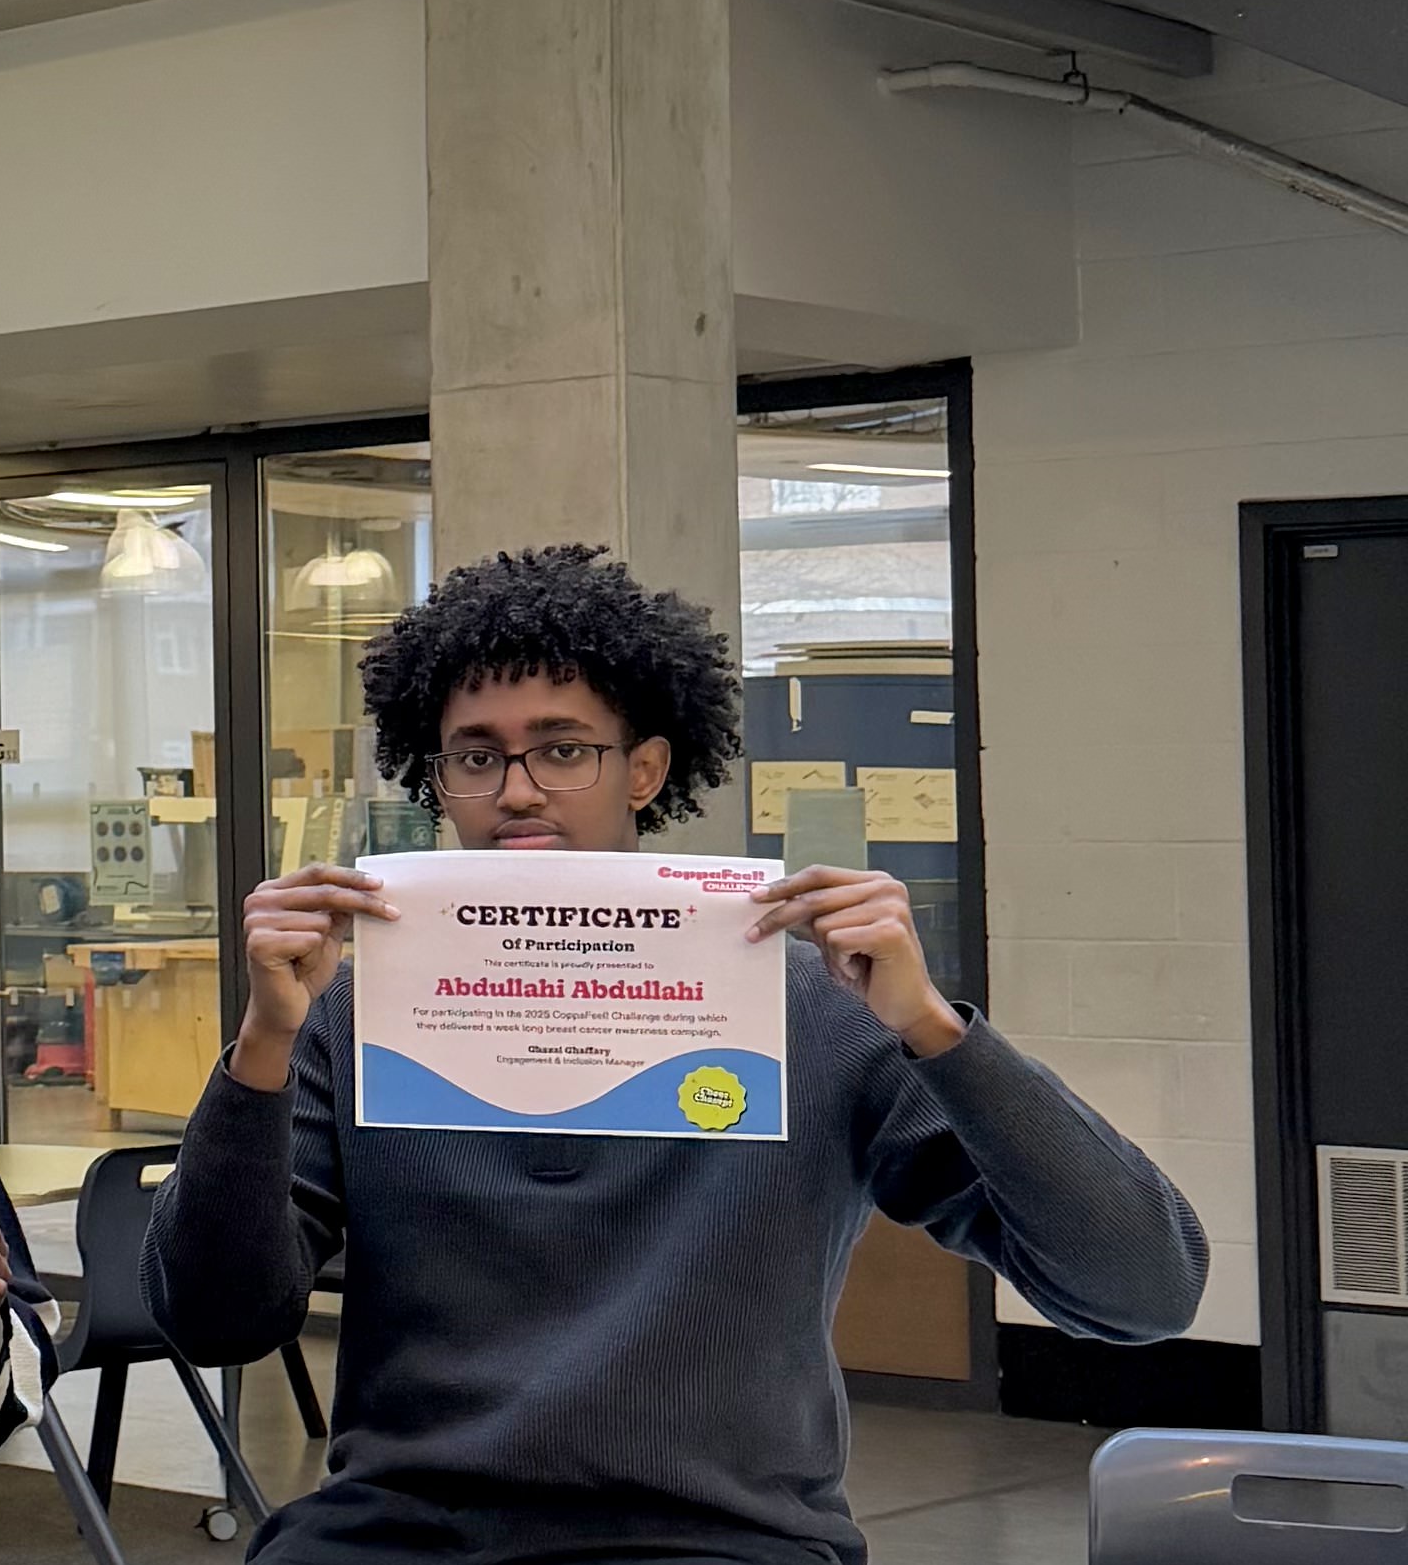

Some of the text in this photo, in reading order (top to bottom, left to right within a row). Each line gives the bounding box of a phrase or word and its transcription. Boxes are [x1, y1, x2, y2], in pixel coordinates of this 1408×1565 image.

[657, 866, 764, 881] CoppaFeel!
[456, 905, 680, 928] CERTIFICATE
[502, 938, 634, 953] Of Participation
[435, 977, 703, 1001] Abdullahi Abdullahi
